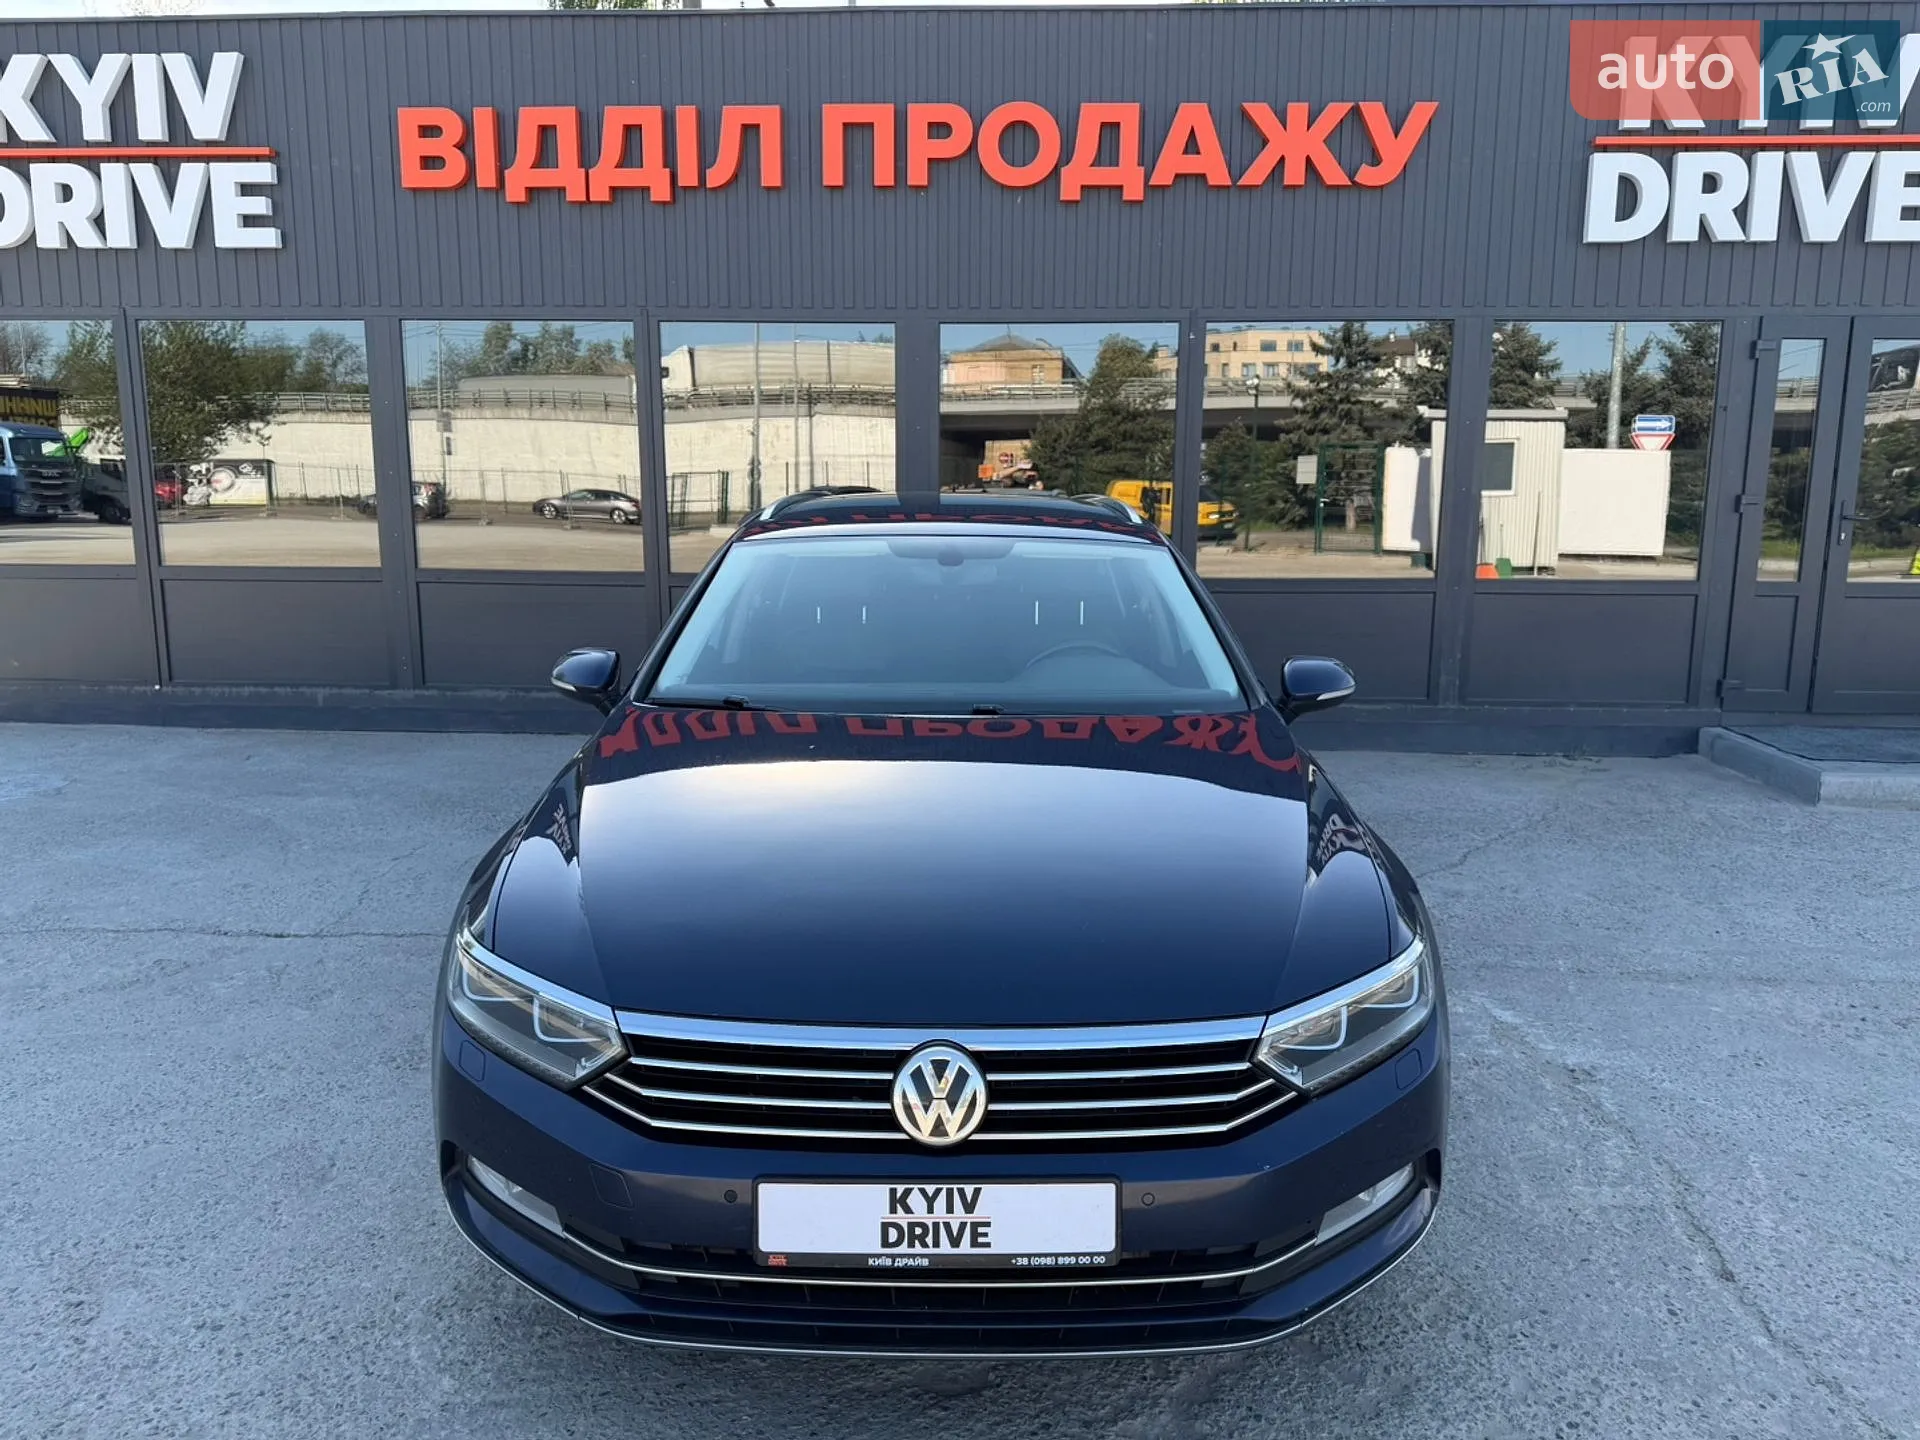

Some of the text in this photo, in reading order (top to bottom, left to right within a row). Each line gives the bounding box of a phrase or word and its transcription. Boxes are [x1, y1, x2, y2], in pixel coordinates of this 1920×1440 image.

[397, 100, 1440, 205] ВІДДІЛ ПРОДАЖУ
[1583, 150, 1920, 244] DRIVE
[889, 1187, 983, 1215] KYIV
[881, 1221, 992, 1249] DRIVE
[868, 1255, 930, 1267] КИЇВ ДРАЙВ
[1011, 1257, 1029, 1266] +38
[1078, 1255, 1091, 1265] 00
[1092, 1255, 1106, 1264] 00
